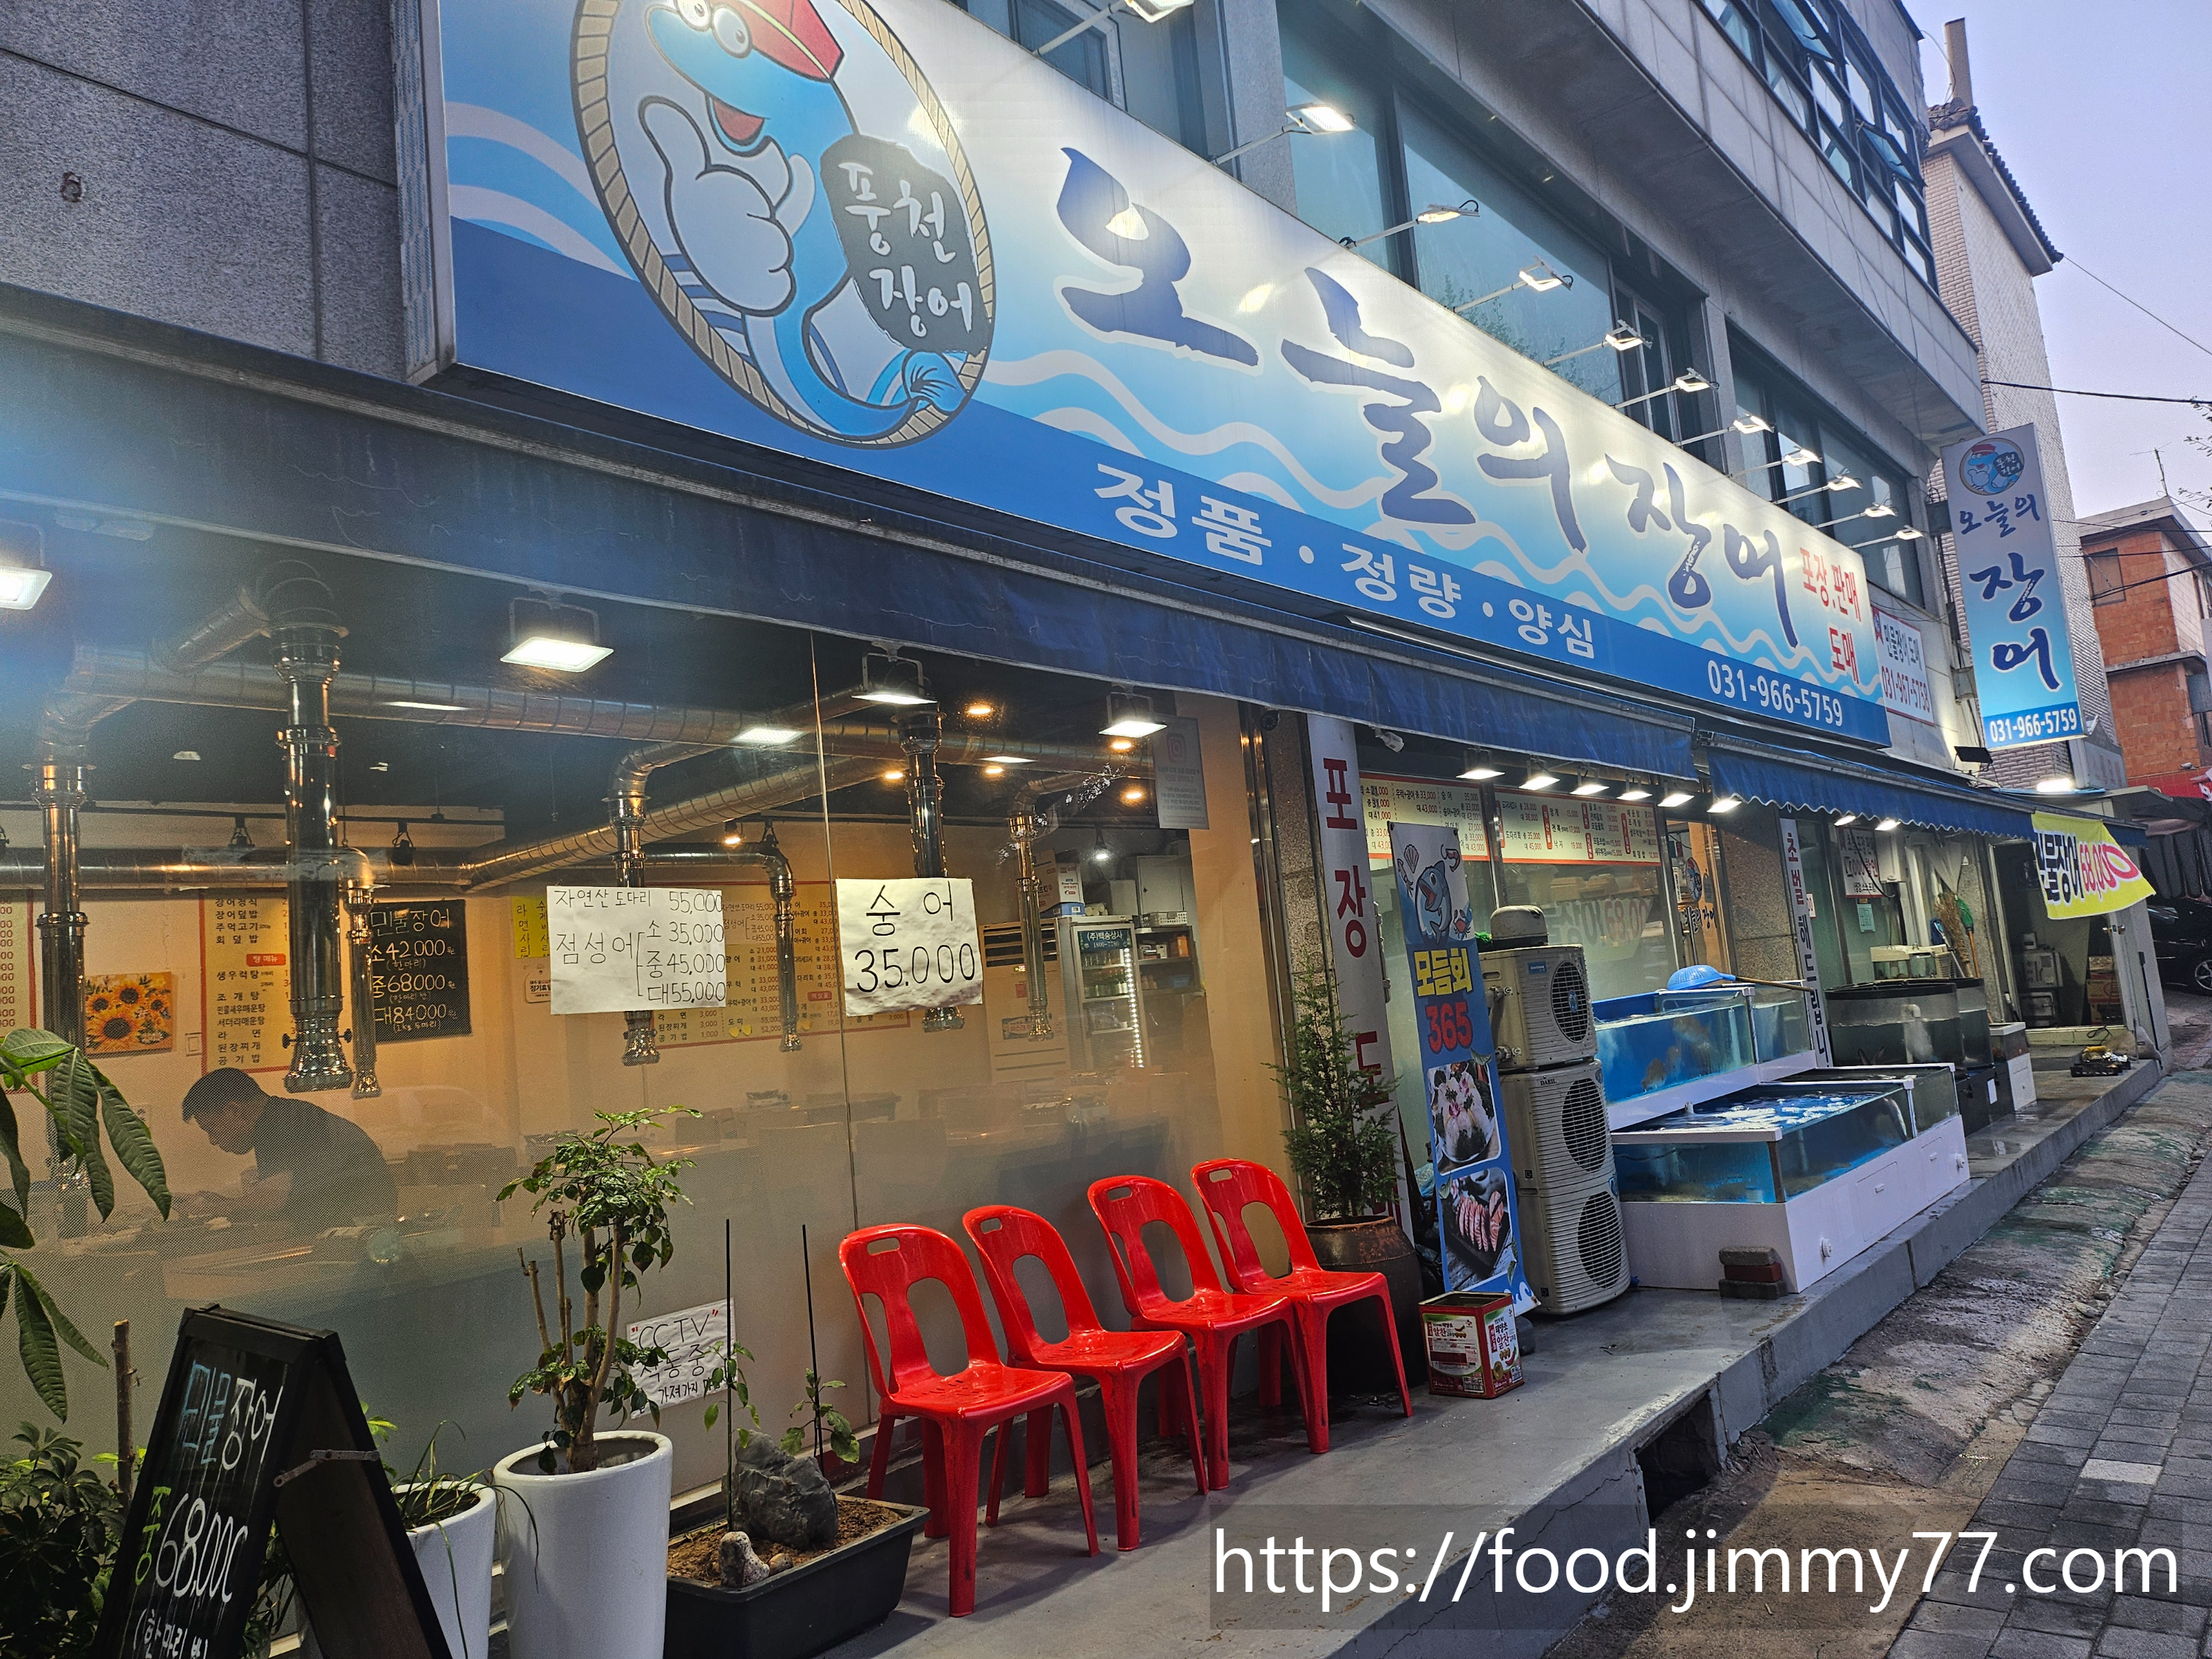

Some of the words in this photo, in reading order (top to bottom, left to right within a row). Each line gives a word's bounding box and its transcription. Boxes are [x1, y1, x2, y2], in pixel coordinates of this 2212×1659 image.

[838, 161, 957, 264] 풍천
[869, 265, 973, 337] 장어
[1057, 146, 1588, 553] 오늘의
[1606, 452, 1798, 648] 장어
[1960, 493, 2041, 539] 오늘의
[1093, 463, 1271, 567] 정품
[1340, 542, 1462, 620] 정량
[1508, 598, 1596, 661] 양심
[1969, 552, 2063, 691] 장어
[1829, 627, 1860, 684] 도매
[1707, 659, 1843, 728] 031-966-5759
[1989, 707, 2078, 743] 031-966-5759
[1371, 786, 1388, 796] 21,000
[1372, 799, 1390, 808] 31,000
[1374, 811, 1391, 820] 41,000
[2079, 843, 2140, 900] 68,000
[554, 888, 610, 908] 자연산
[615, 889, 651, 907] 도다리
[669, 891, 723, 915] 55,000
[646, 920, 662, 938] 소
[669, 921, 724, 945] 35,000
[757, 924, 773, 933] 45,00
[646, 950, 663, 978] 중
[667, 953, 726, 975] 45,000
[1413, 947, 1473, 998] 모듬회
[672, 981, 726, 1004] 55,000
[1425, 1001, 1473, 1054] 365
